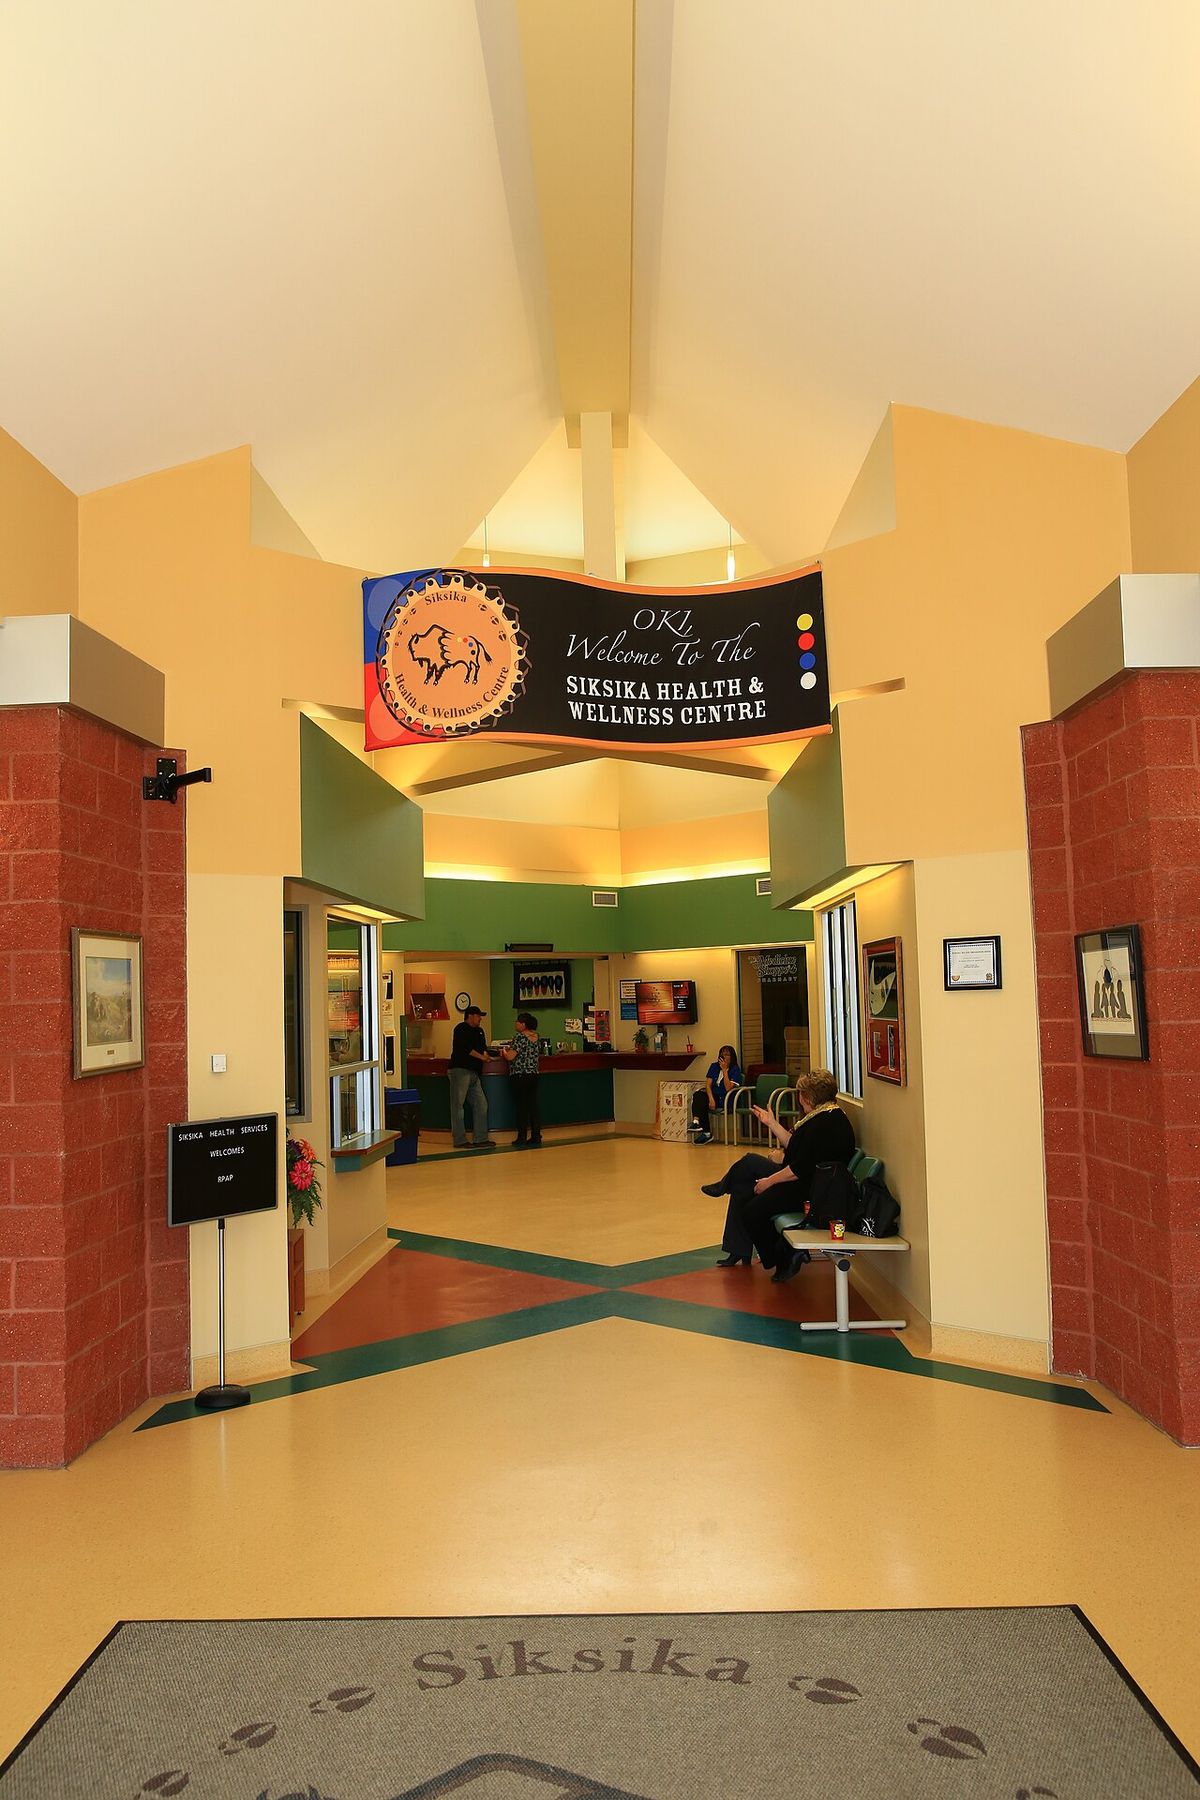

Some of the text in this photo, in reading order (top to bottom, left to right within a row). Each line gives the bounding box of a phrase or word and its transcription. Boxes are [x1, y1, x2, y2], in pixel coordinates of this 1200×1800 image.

[425, 591, 467, 605] Siksika
[566, 622, 761, 666] Welcome To The
[395, 666, 510, 719] Health & Wellness Centre
[566, 675, 764, 700] SIKSIKA HEALTH &
[568, 699, 766, 726] WELLNESS CENTRE
[178, 1124, 268, 1142] SIKSIKA HEALTH SERVICES
[209, 1146, 245, 1158] WELCOMES
[217, 1174, 234, 1183] RPAP
[412, 1637, 752, 1691] Siksika
